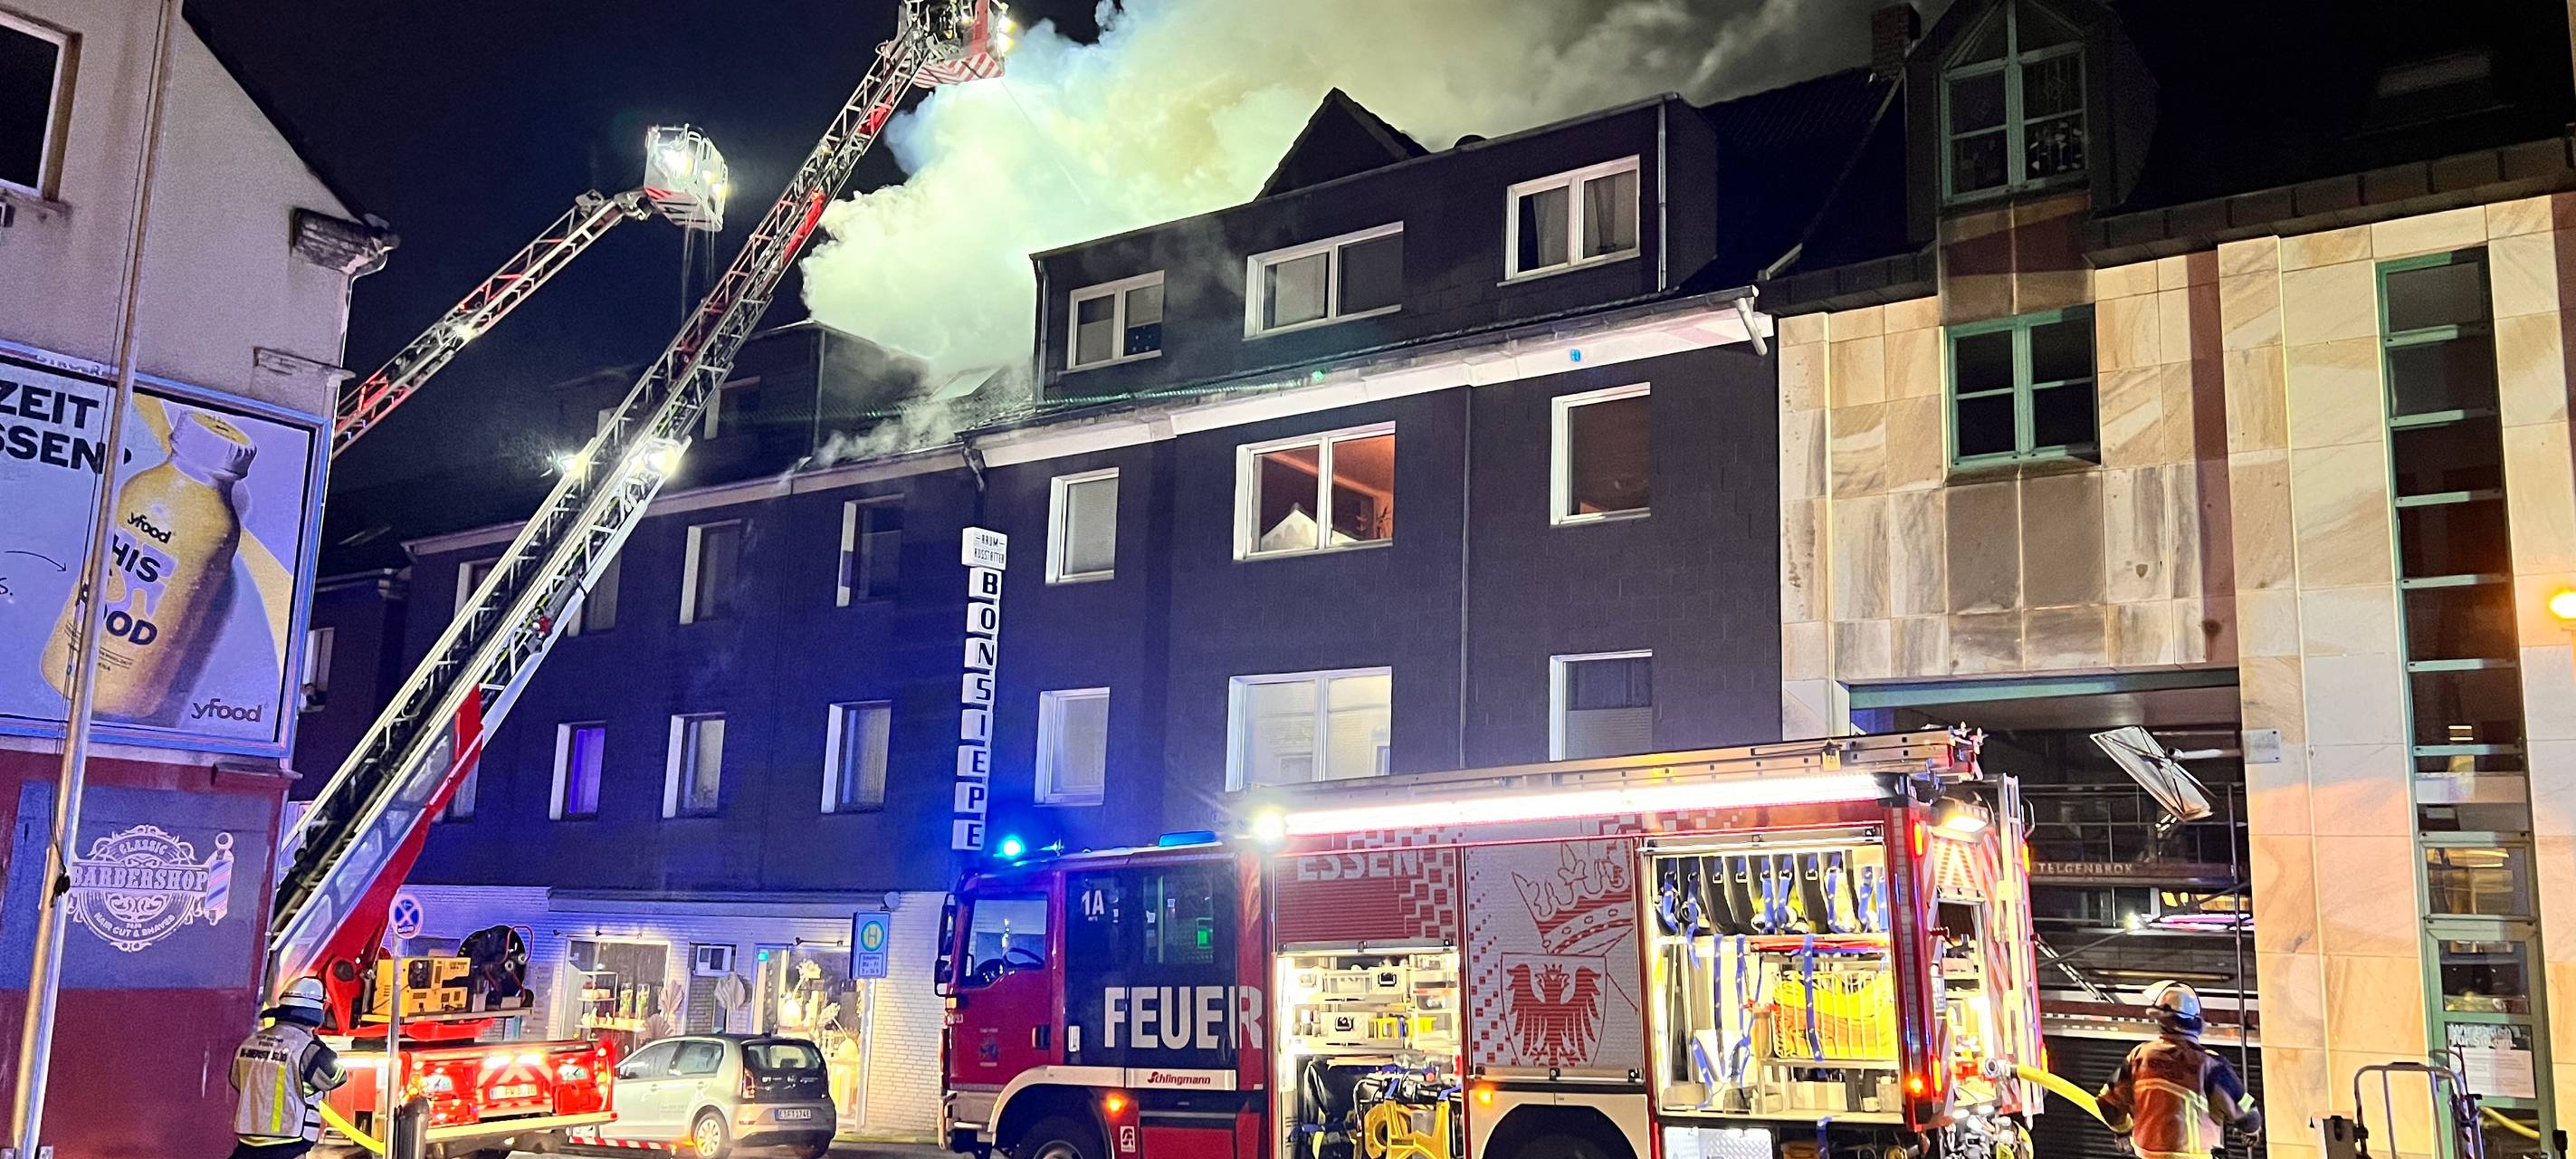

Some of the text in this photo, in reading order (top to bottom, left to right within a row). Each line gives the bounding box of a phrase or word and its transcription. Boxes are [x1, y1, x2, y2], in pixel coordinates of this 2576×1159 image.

[0, 380, 100, 430] ZEIT
[128, 512, 172, 544] yfood
[111, 533, 161, 583] HIS
[191, 698, 262, 723] yfood
[967, 571, 998, 848] BONSIEPE
[119, 839, 168, 856] CLASSIC
[71, 866, 208, 891] BARBERSHOP
[1082, 890, 1104, 915] 1A
[94, 912, 113, 931] HAIR
[112, 926, 131, 937] CUT
[1104, 985, 1263, 1049] FEUER
[1148, 1071, 1211, 1087] Schlingmann
